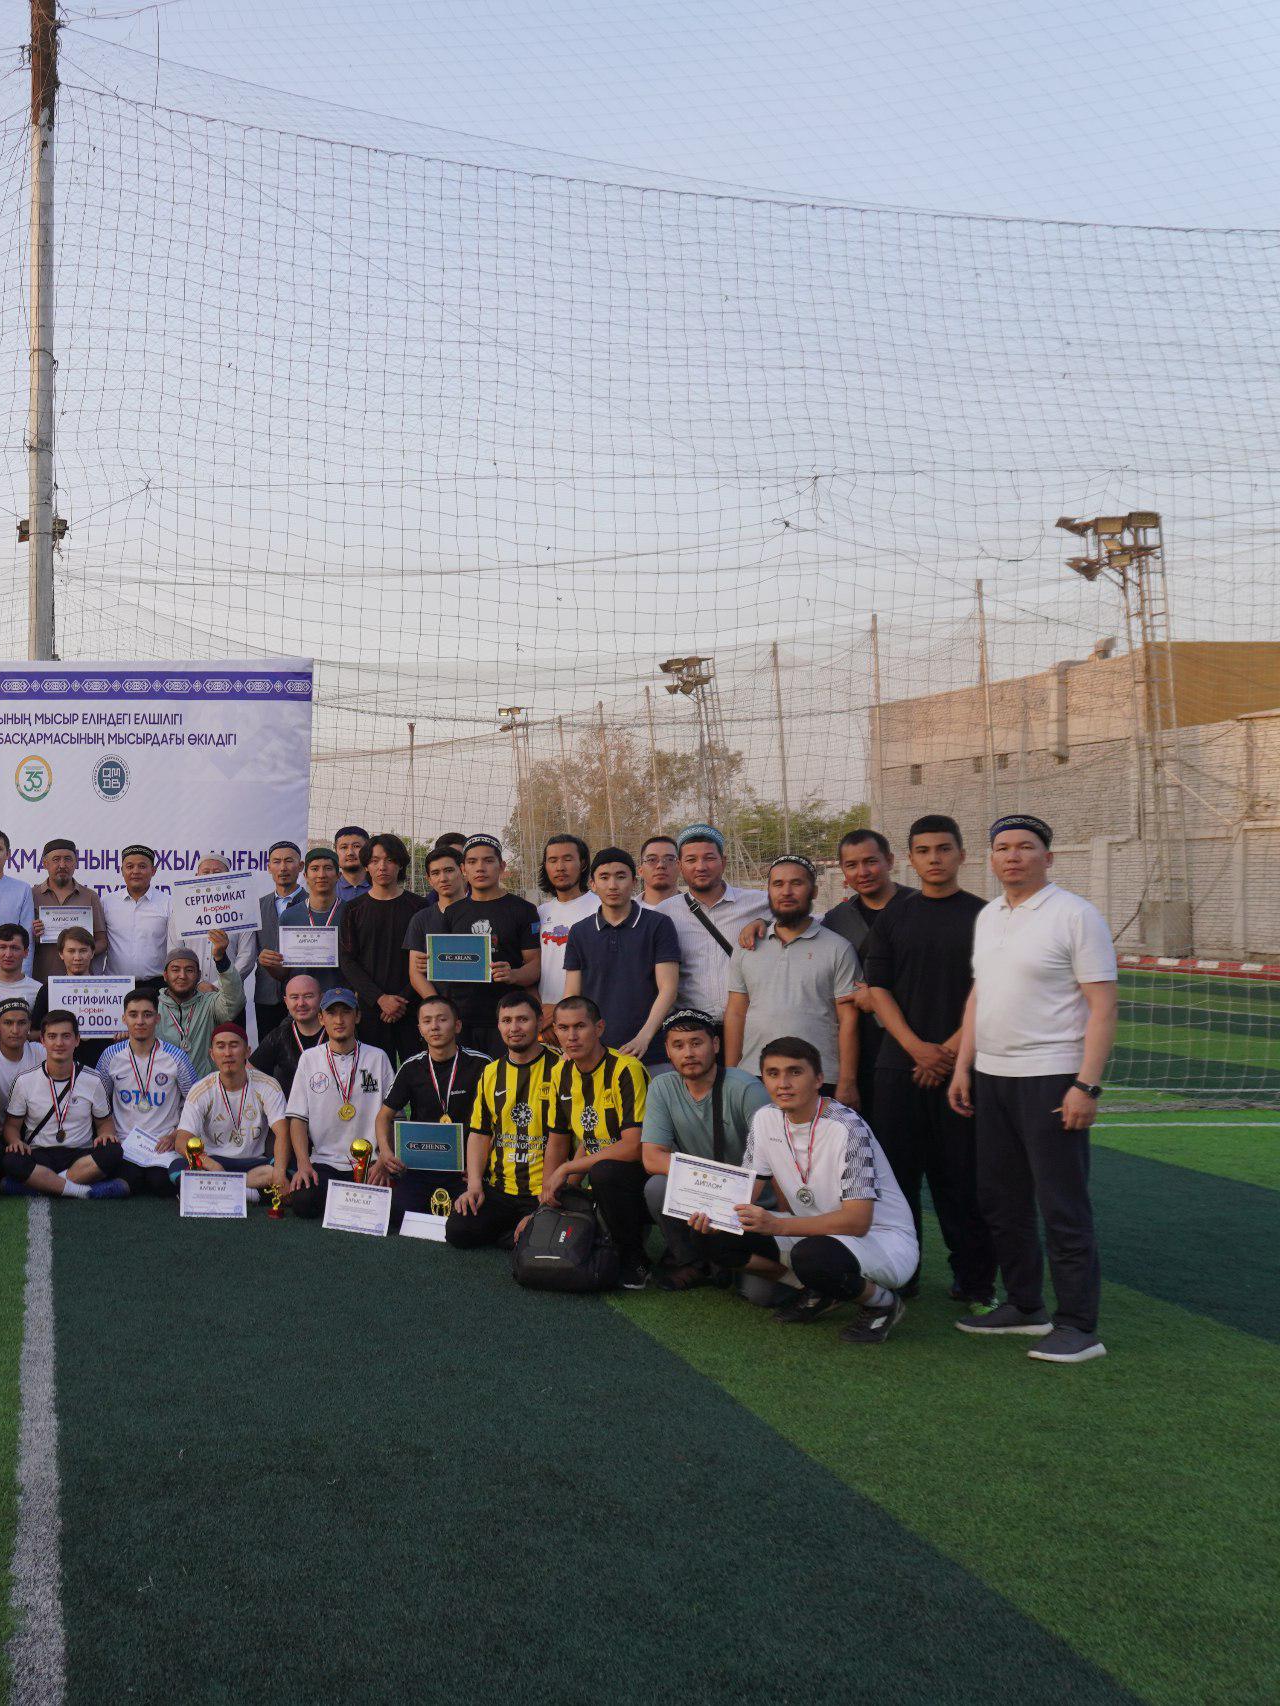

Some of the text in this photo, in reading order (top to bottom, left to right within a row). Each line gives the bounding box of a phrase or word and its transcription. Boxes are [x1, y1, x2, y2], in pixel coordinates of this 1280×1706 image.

[34, 713, 79, 725] МЫСЫР
[81, 713, 131, 726] ЕЛІНДЕГІ
[134, 713, 183, 726] ЕЛШІЛІГІ
[107, 733, 185, 746] МЫСЫРДАҒЫ
[187, 733, 237, 747] ӨКІЛДІГІ
[24, 771, 43, 791] 35
[185, 889, 246, 907] СЕРТИФИКАТ
[195, 914, 212, 926] 40
[215, 911, 238, 924] 000
[61, 995, 123, 1005] СЕРТИФИКАТ
[88, 1015, 112, 1026] 000
[694, 1179, 723, 1190] ДИПЛОМ
